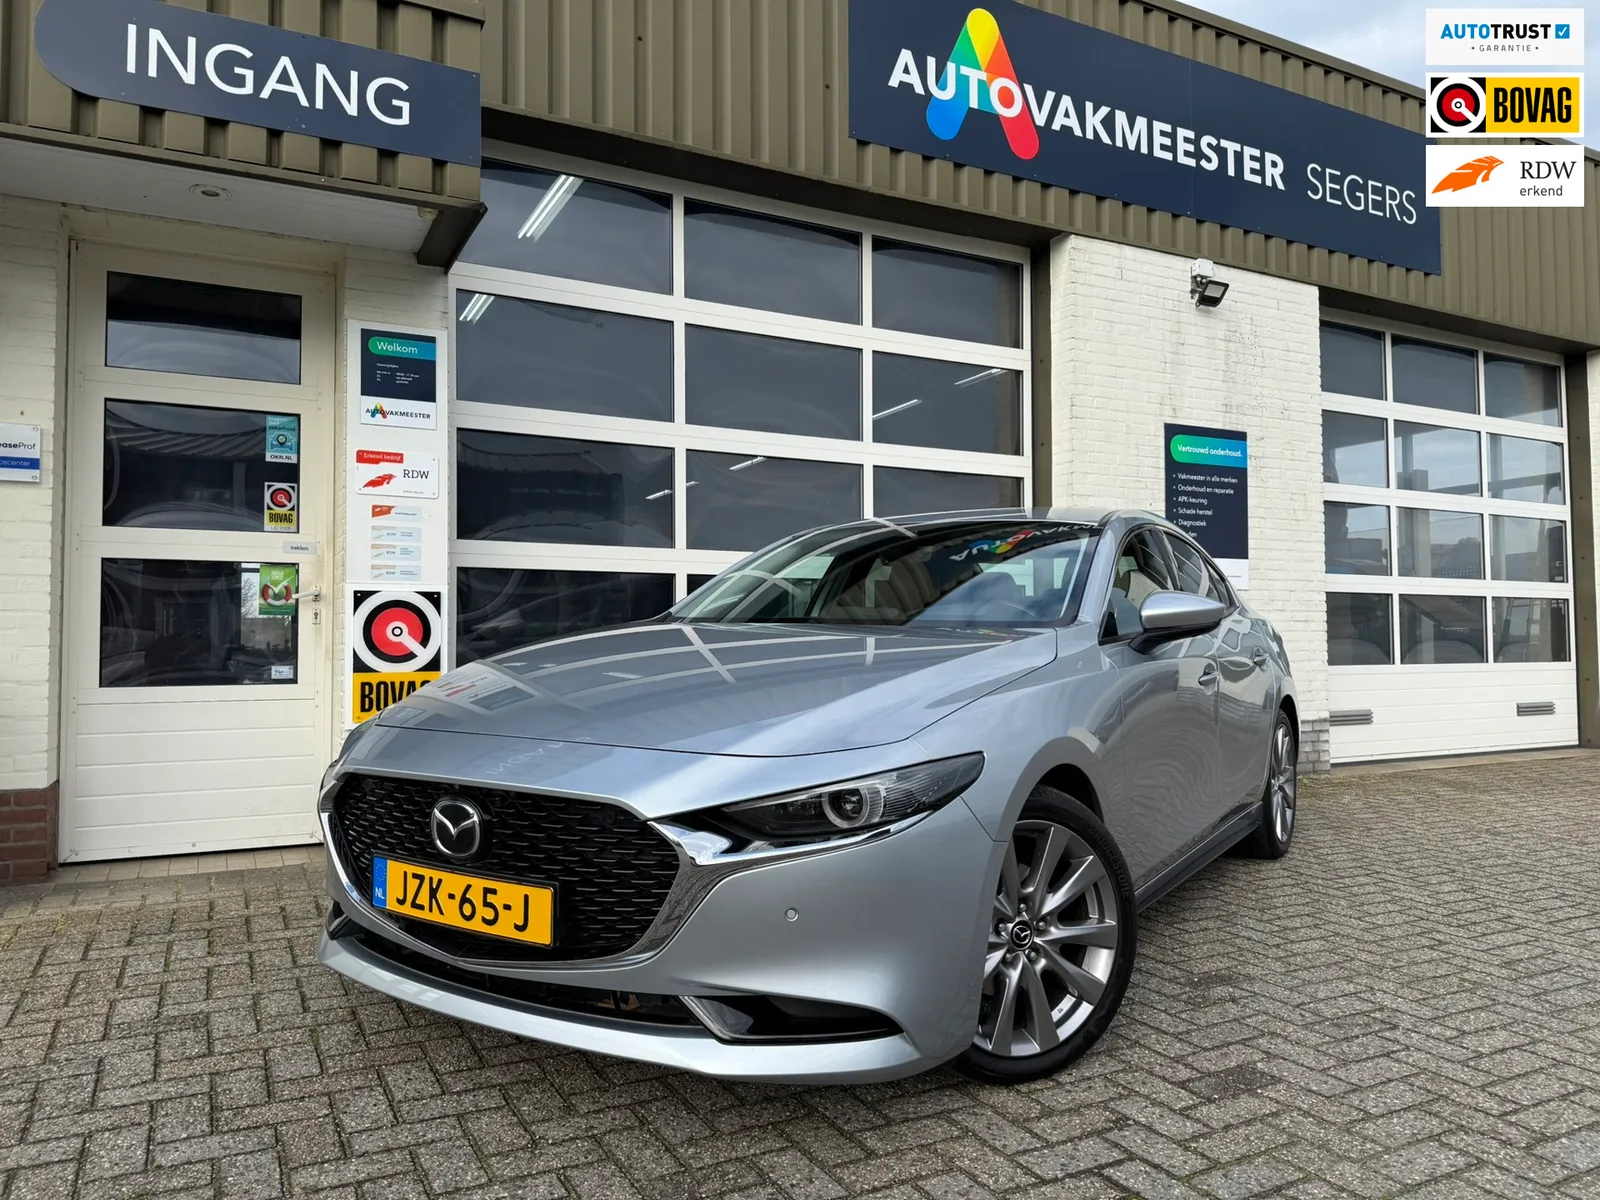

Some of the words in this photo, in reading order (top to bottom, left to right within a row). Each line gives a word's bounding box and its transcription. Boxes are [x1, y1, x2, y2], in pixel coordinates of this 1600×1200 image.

[126, 23, 410, 126] INGANG
[887, 48, 1286, 191] AUTOVAKMEESTER
[1306, 163, 1417, 215] SEGERS
[376, 341, 418, 354] Welkom
[365, 408, 431, 420] AUTOVAKMEESTER
[0, 441, 36, 450] aseProf
[1177, 443, 1209, 454] Vertrouwd
[383, 454, 401, 462] bedrijf
[403, 468, 430, 480] RDW
[1177, 472, 1206, 481] Vakmeester
[1177, 484, 1206, 492] Onderhoud
[1177, 496, 1208, 505] APK-keuring
[269, 512, 293, 524] BOVAG
[1178, 518, 1207, 527] Diagnostiek
[360, 680, 432, 713] BOVA
[375, 886, 385, 899] NL
[396, 870, 530, 932] JZK-65-J
